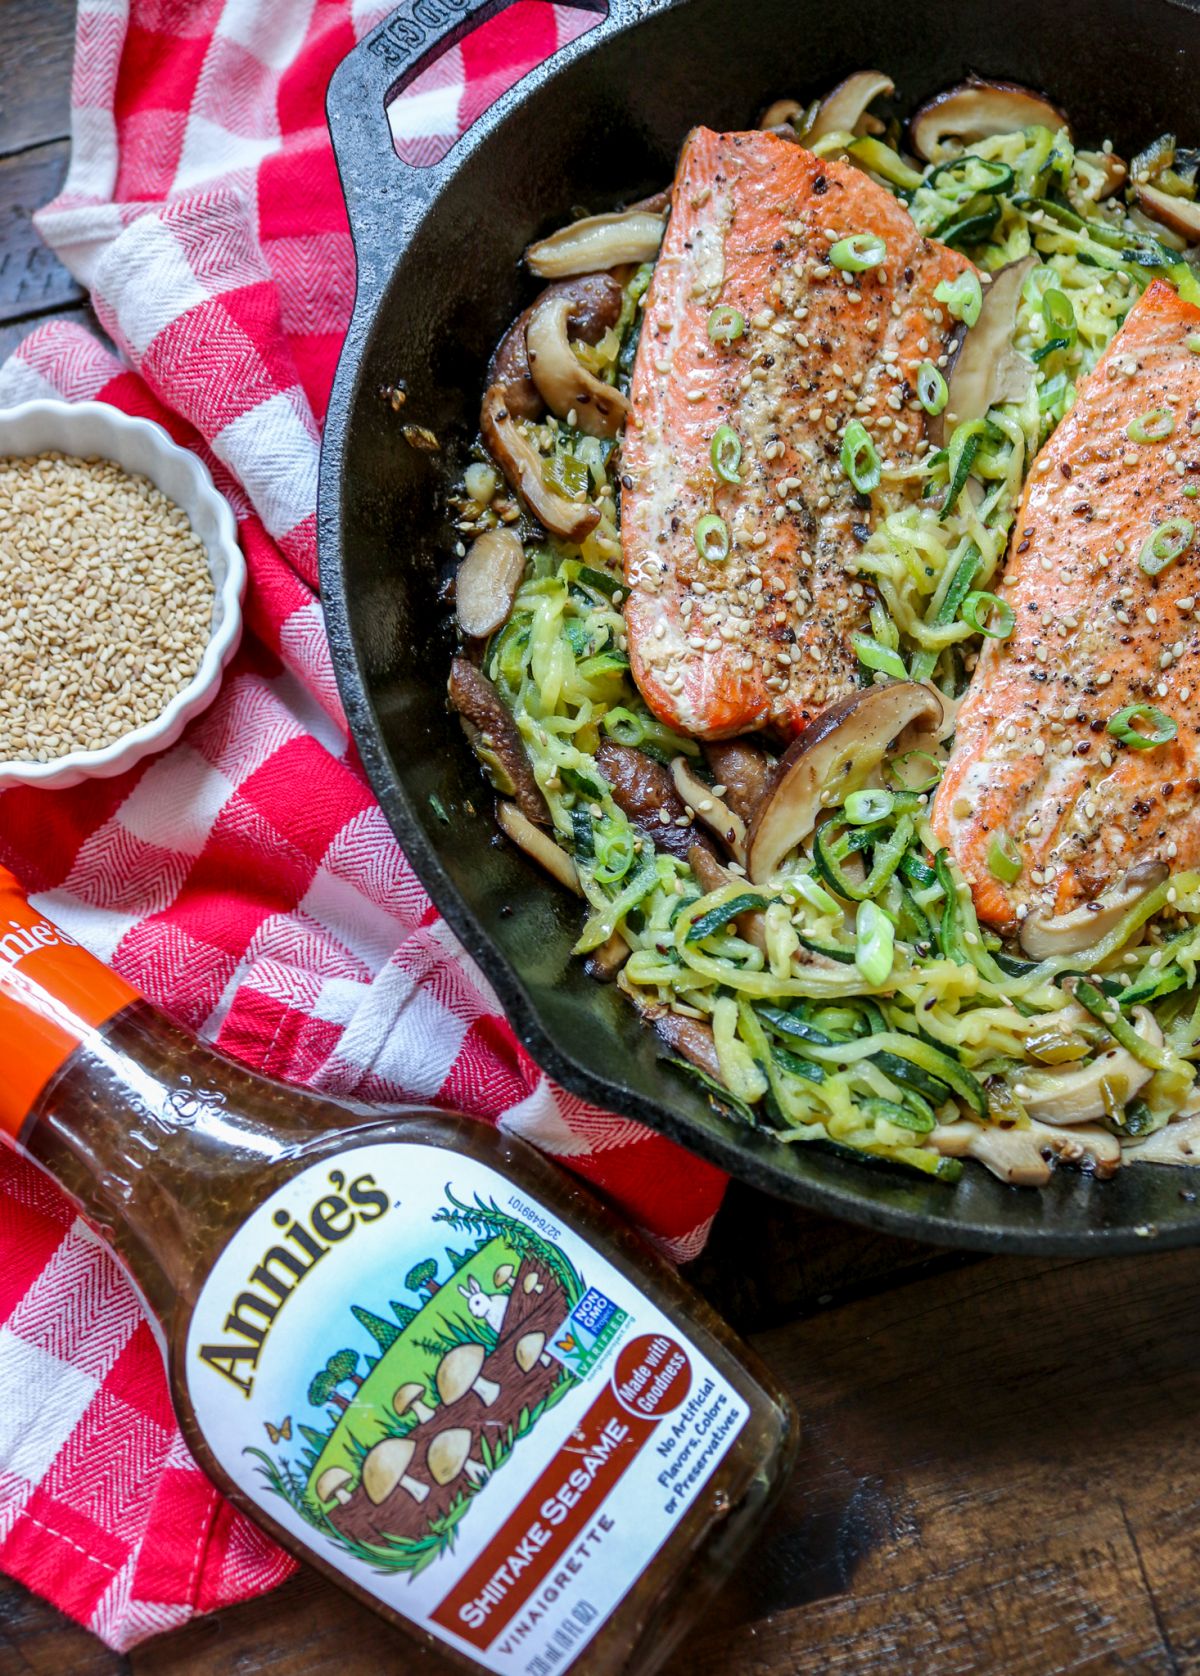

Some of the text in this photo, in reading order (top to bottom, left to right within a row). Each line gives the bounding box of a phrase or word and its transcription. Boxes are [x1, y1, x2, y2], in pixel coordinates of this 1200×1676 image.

[508, 1195, 562, 1241] 3276489101
[199, 1169, 390, 1398] Annie's
[574, 1291, 600, 1322] NON
[583, 1297, 608, 1328] GMO
[579, 1312, 625, 1372] VERIFIED
[619, 1337, 671, 1402] Made with
[637, 1351, 687, 1413] Goodness
[656, 1377, 716, 1458] No Artificial
[657, 1393, 728, 1488] Flavors, Colors
[664, 1408, 740, 1514] or Preservatives
[458, 1417, 629, 1629] SHIITAKE SESAME
[498, 1513, 616, 1655] VINAIGRETTE
